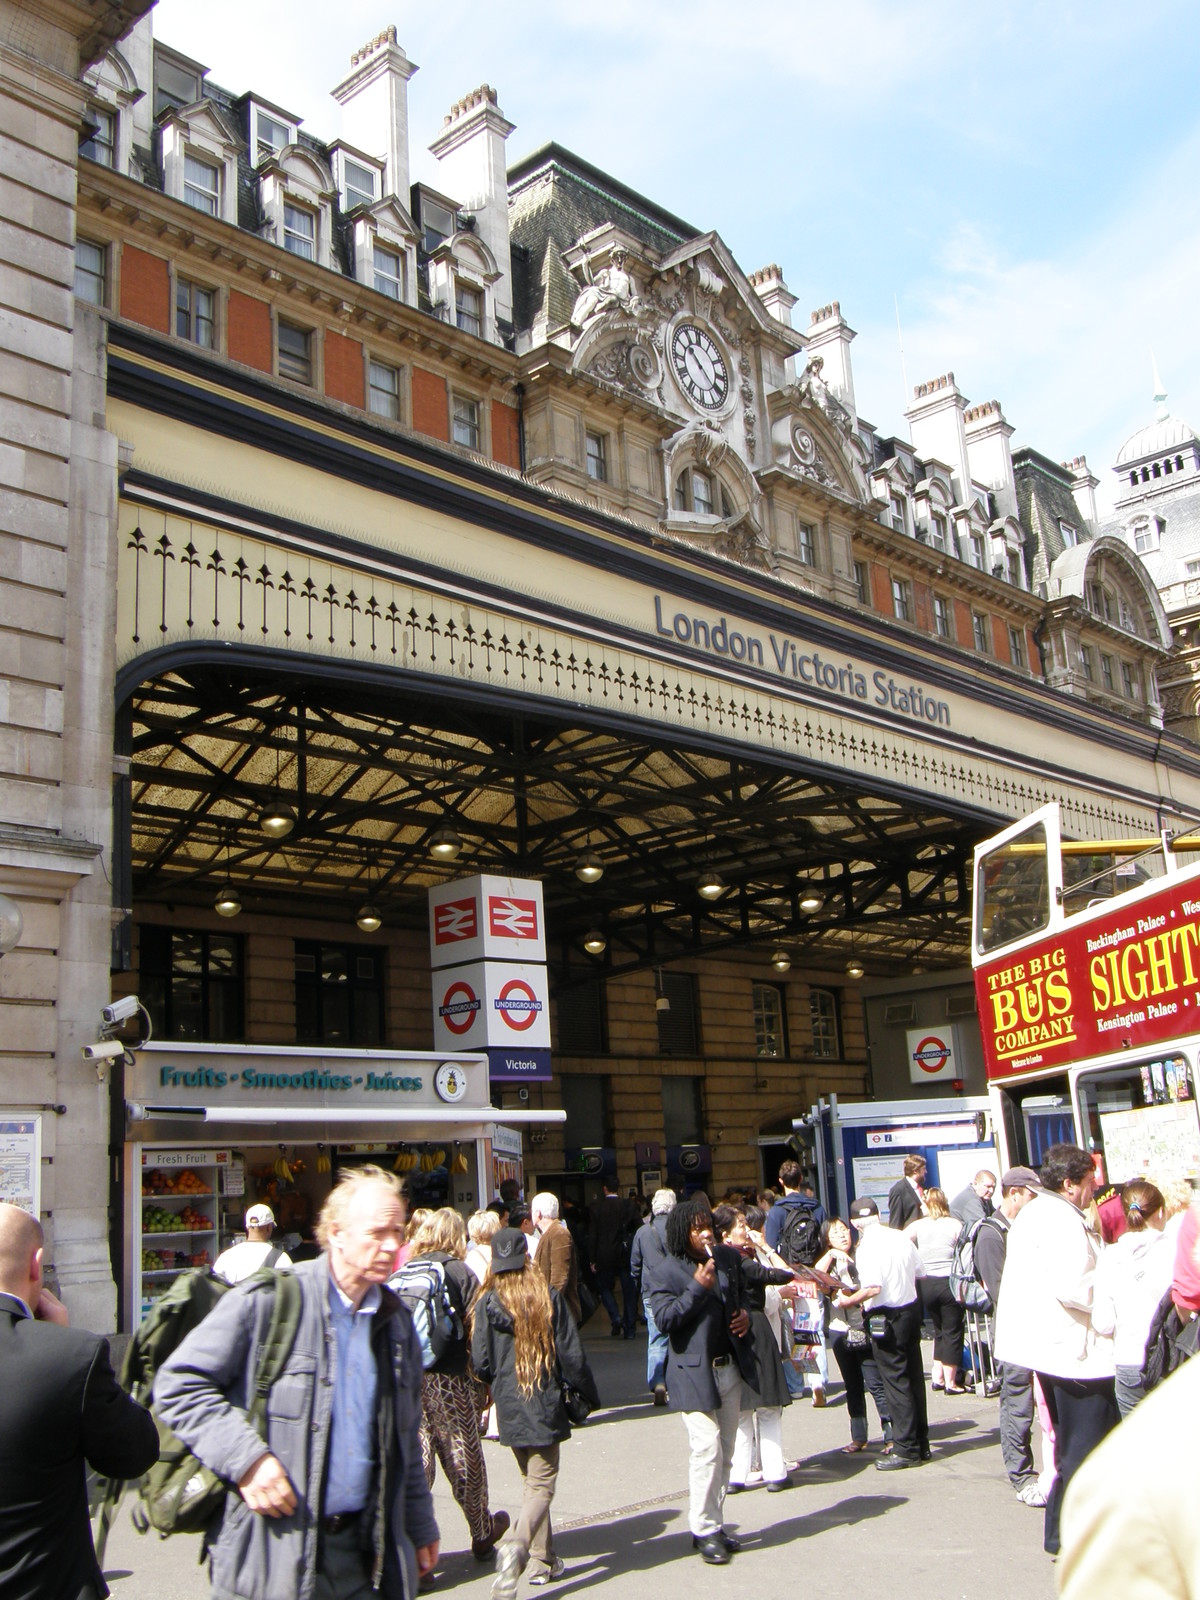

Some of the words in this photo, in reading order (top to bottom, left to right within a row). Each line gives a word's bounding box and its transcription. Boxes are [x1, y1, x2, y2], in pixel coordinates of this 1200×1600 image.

[654, 595, 764, 665] London
[769, 634, 868, 699] Victoria
[873, 671, 951, 725] Station
[1086, 926, 1136, 953] Buckingham
[1136, 914, 1166, 934] Palace
[987, 964, 1026, 991] THE
[1029, 948, 1067, 977] BIG
[1090, 922, 1200, 1012] SIGHT
[441, 1002, 480, 1015] UNDERGROUND
[495, 1001, 542, 1010] UNDERGROUND
[989, 967, 1073, 1034] BUS
[1096, 1008, 1146, 1033] Kensington
[1147, 1002, 1178, 1020] Palace
[995, 1015, 1075, 1052] COMPANY
[505, 1060, 537, 1070] Victoria
[913, 1050, 950, 1060] UNDERGROUND
[160, 1065, 228, 1087] Fruits
[241, 1068, 352, 1090] Smoothies
[363, 1071, 423, 1091] Juices
[157, 1154, 183, 1164] Fresh
[186, 1153, 207, 1163] Fruit
